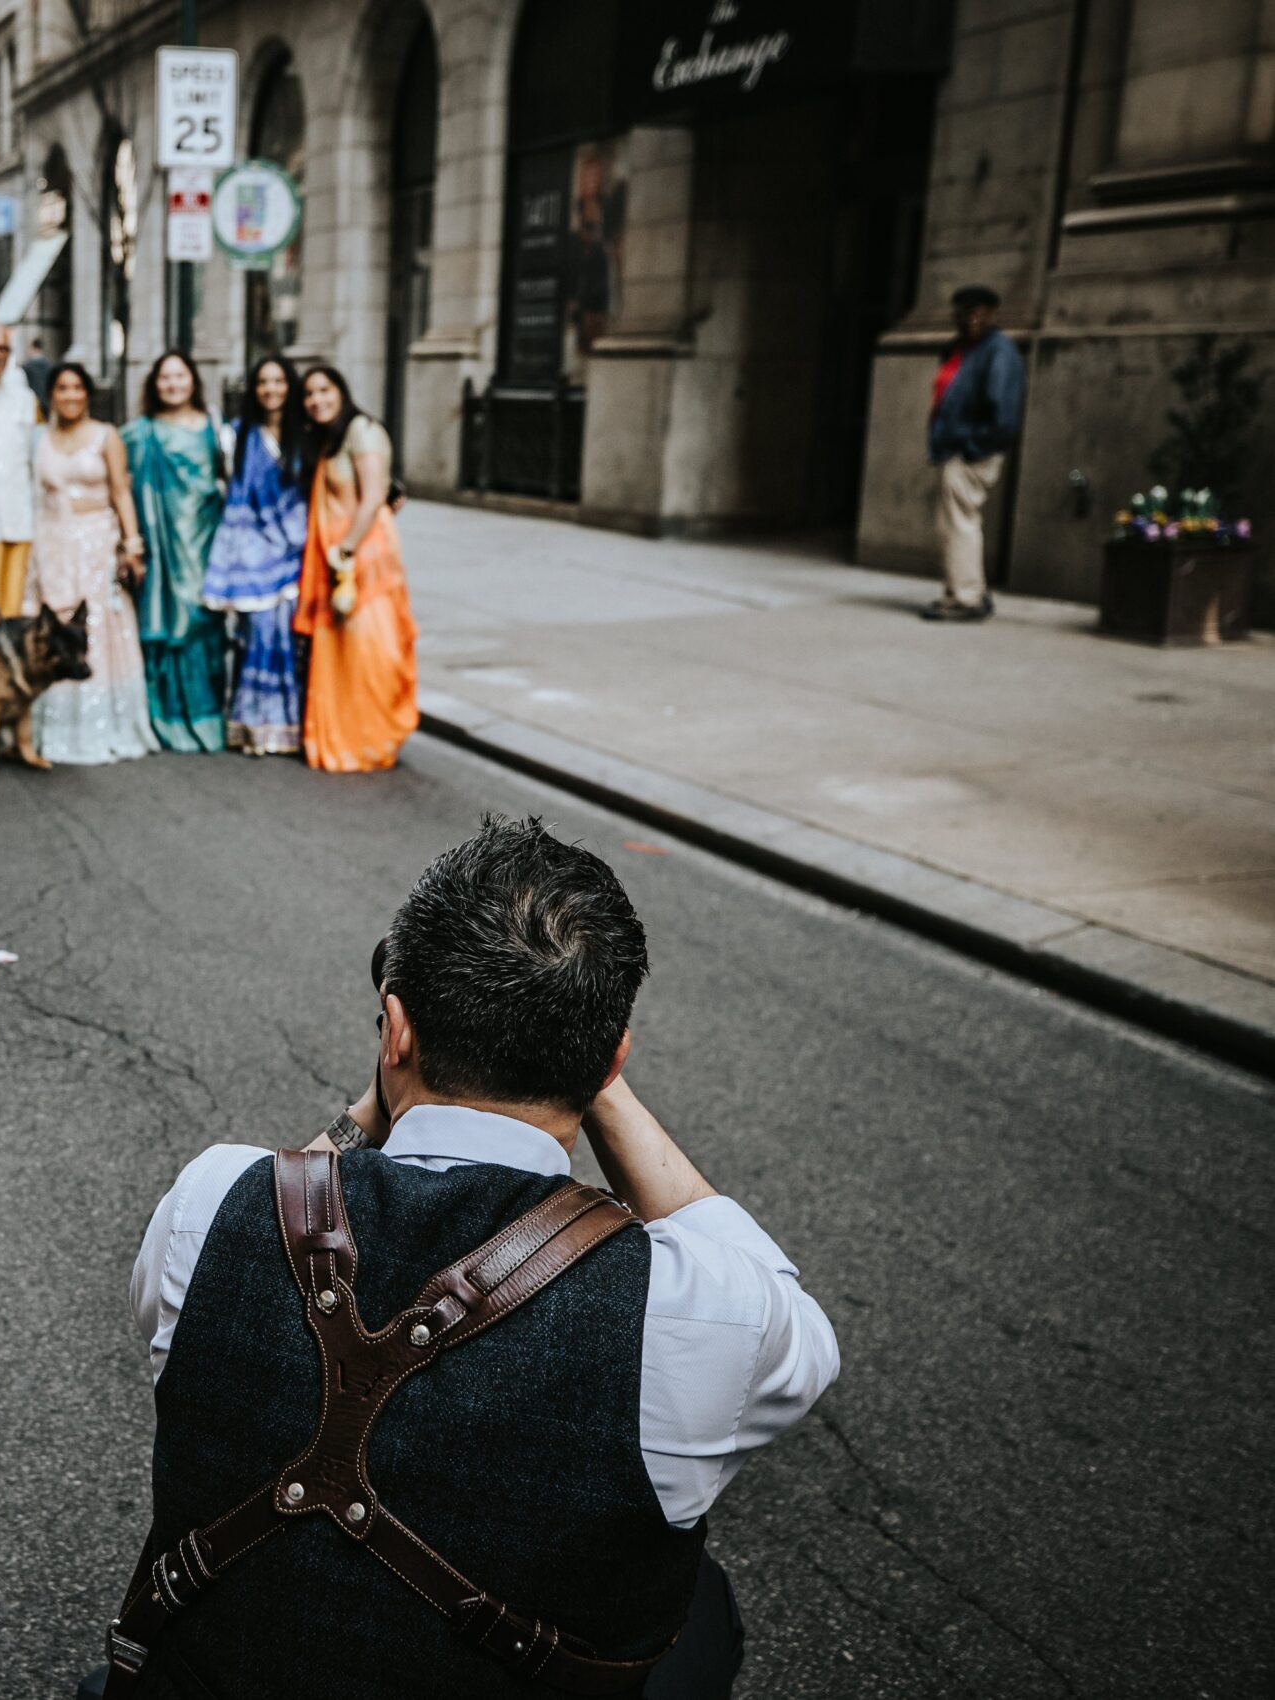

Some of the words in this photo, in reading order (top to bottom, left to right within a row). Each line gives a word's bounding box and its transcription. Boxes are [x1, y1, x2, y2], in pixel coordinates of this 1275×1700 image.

[170, 65, 226, 82] SPEED
[653, 31, 789, 91] Exchange
[173, 90, 222, 105] LIMIT
[174, 115, 223, 153] 25
